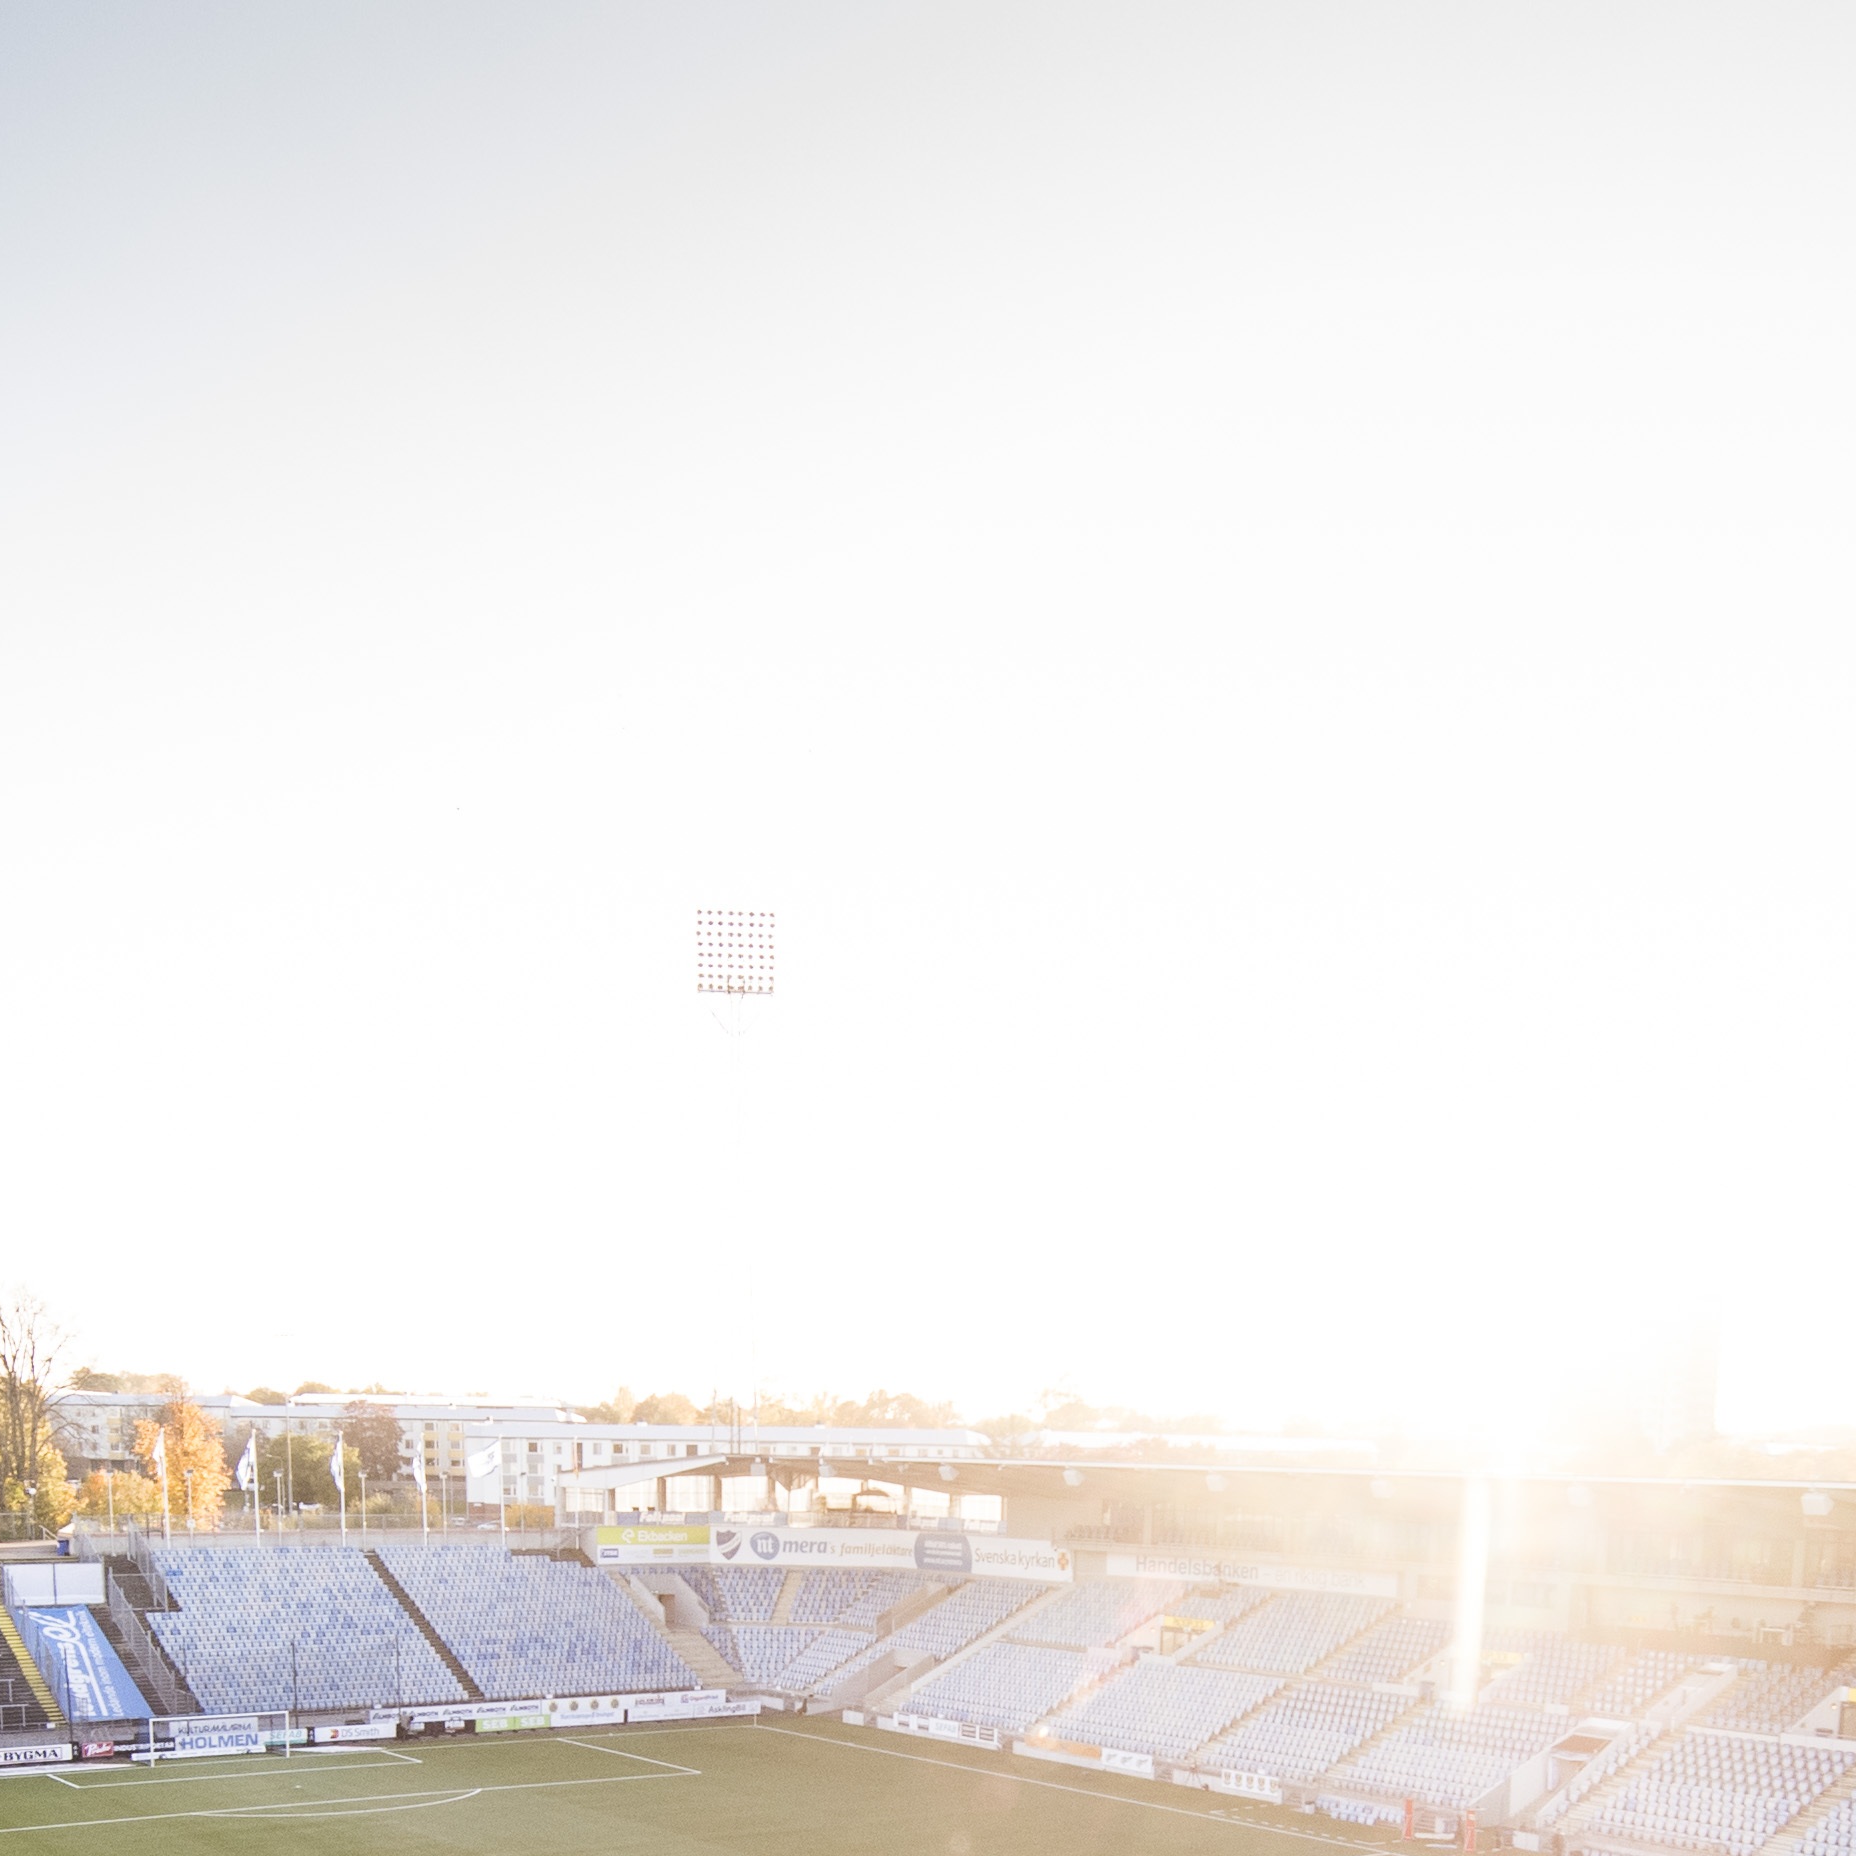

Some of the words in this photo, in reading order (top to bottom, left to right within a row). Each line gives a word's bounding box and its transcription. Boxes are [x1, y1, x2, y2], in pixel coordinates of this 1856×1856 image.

[638, 1530, 687, 1542] Ekbacken
[1136, 1556, 1258, 1580] Handelsbanken
[482, 1719, 507, 1729] SEB
[520, 1717, 544, 1726] SEB
[341, 1728, 352, 1737] DS
[355, 1726, 380, 1737] Smith
[183, 1733, 258, 1749] HOLMEN
[4, 1750, 59, 1761] BYGMA
